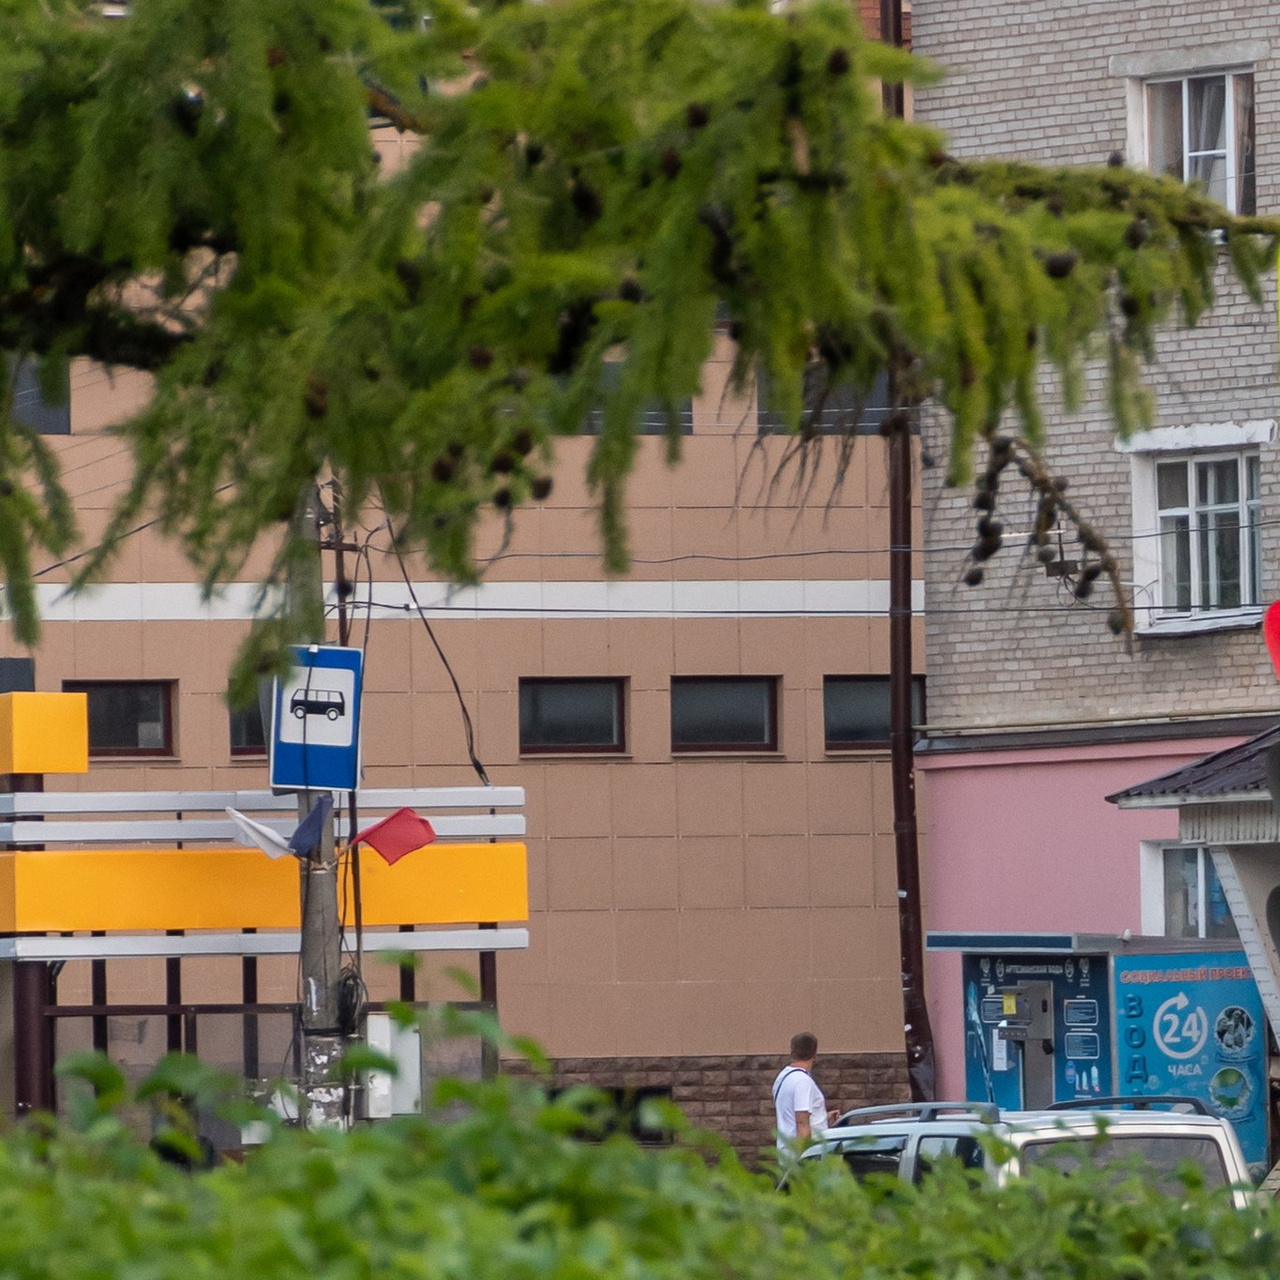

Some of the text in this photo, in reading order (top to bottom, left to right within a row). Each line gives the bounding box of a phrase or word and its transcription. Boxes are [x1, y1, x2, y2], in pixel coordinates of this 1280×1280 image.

[1120, 966, 1208, 985] СОЦИАЛЬНЫЙ
[1163, 1013, 1201, 1043] 24
[1123, 993, 1148, 1095] ВОД
[1167, 1064, 1202, 1076] ЧАСА
